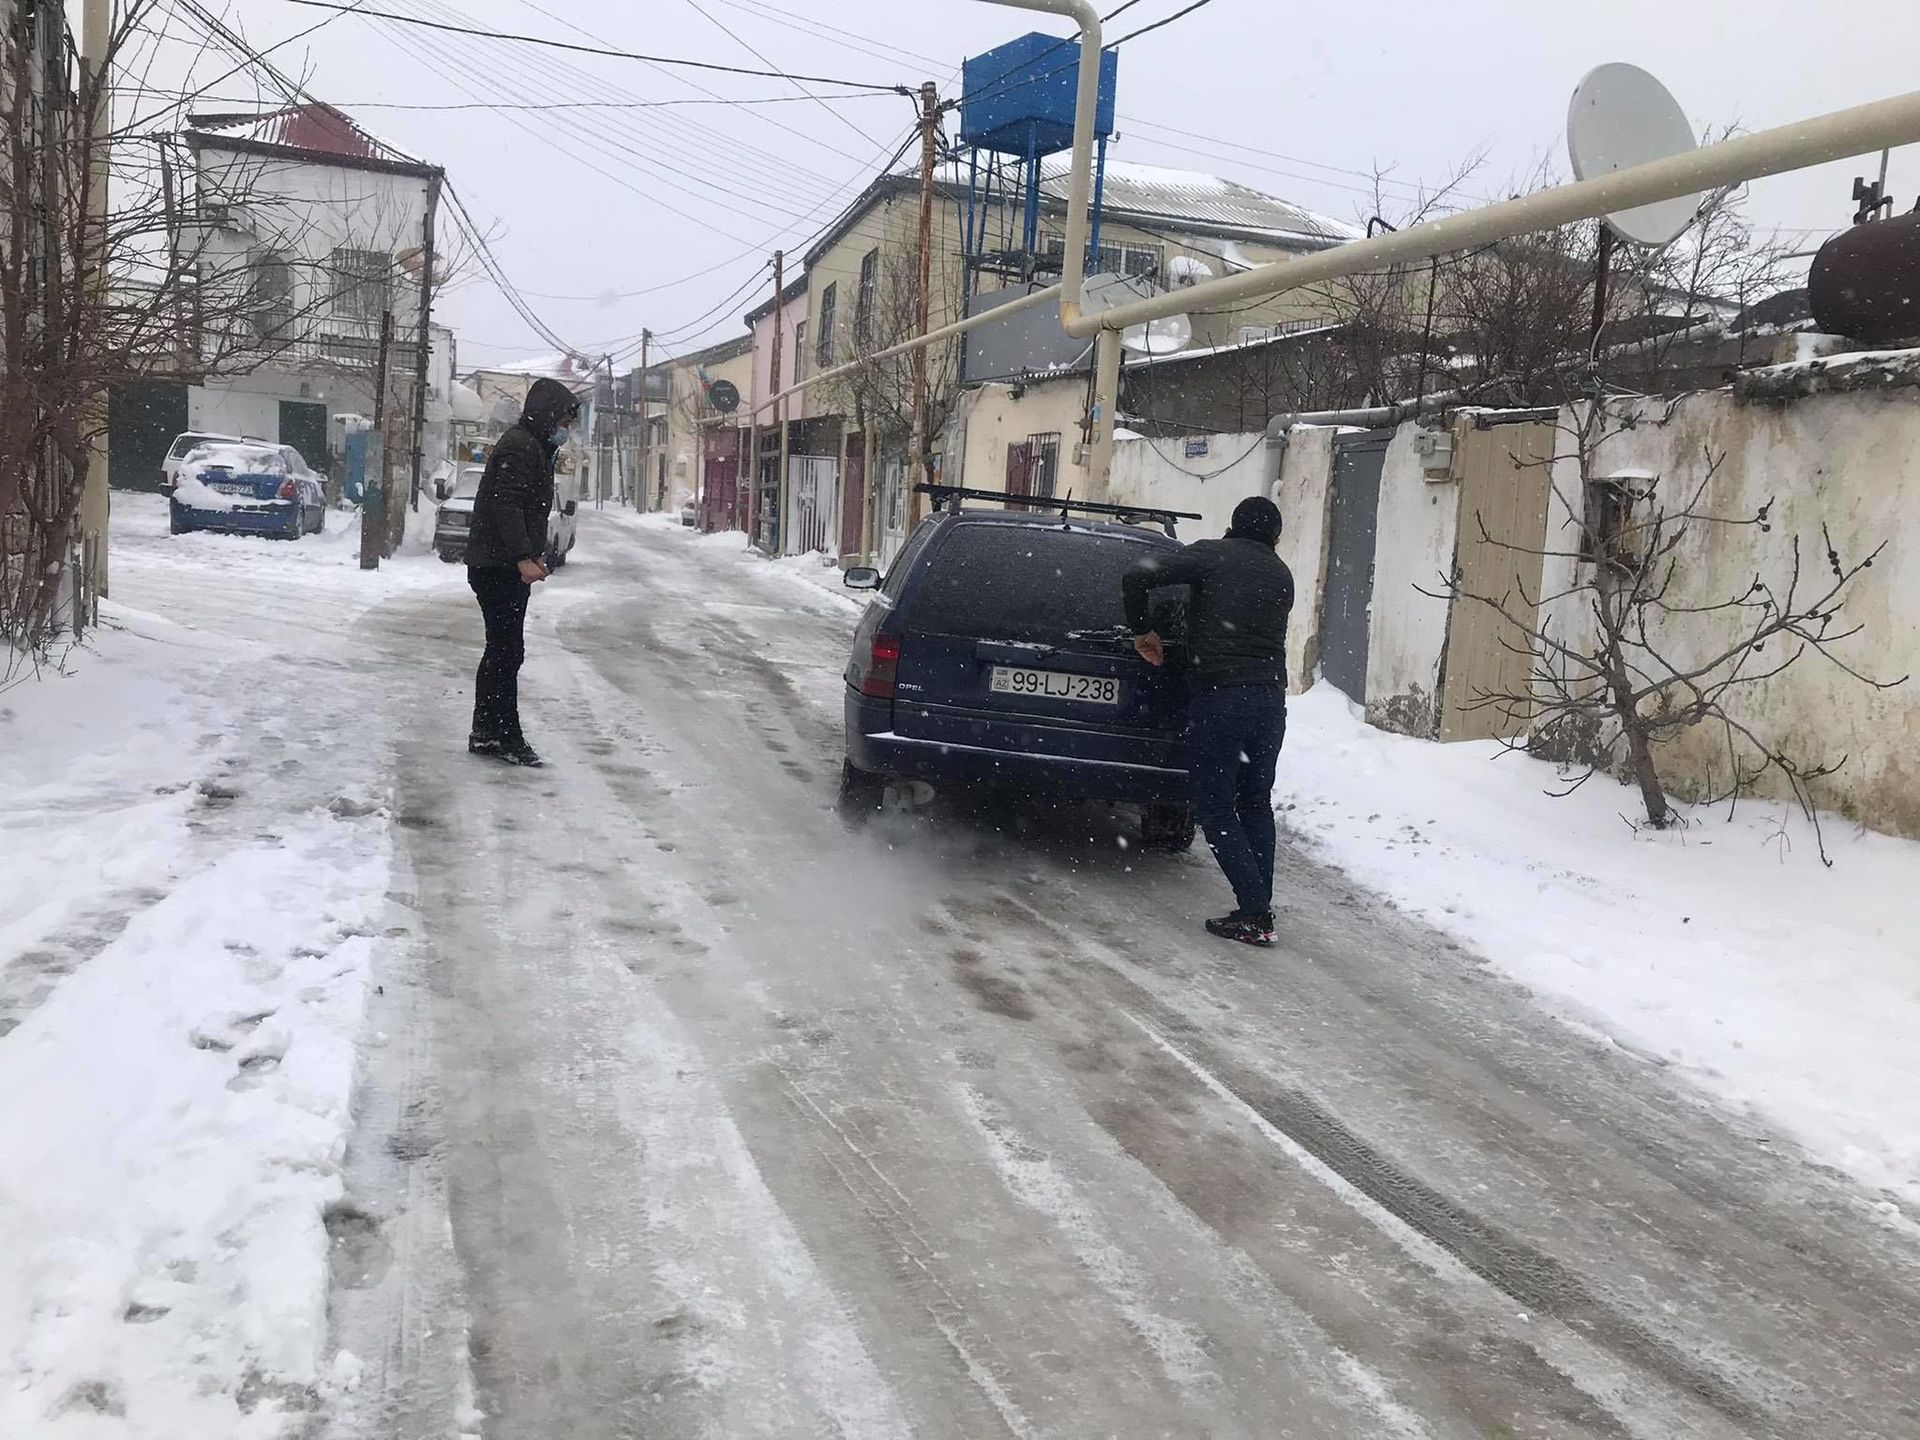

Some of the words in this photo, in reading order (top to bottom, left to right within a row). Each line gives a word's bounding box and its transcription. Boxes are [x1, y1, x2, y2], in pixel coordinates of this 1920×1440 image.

[898, 682, 924, 692] OPEL
[995, 679, 1007, 688] AZ
[1012, 671, 1115, 702] 99-LJ-238
